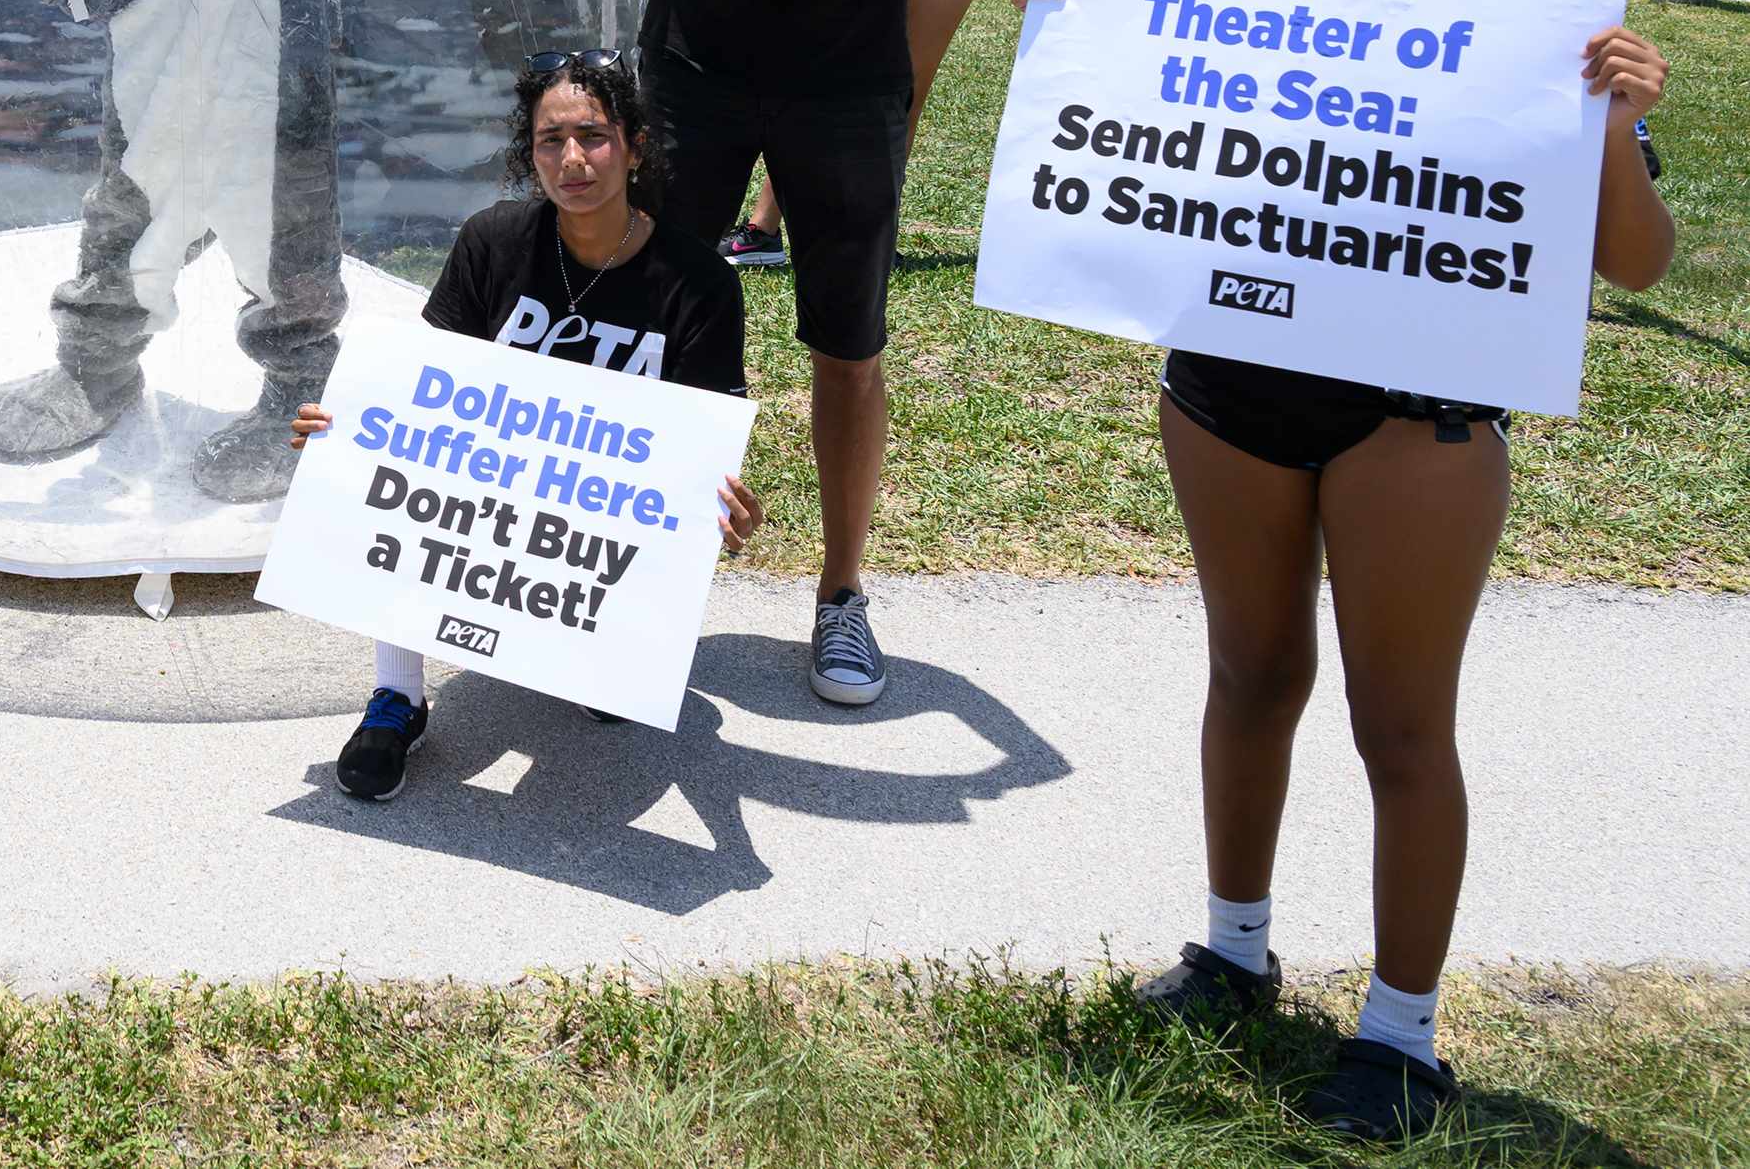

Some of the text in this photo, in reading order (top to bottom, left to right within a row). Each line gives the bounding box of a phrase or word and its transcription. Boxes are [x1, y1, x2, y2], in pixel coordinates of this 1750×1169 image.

[1161, 57, 1417, 137] the Sea:
[1397, 21, 1474, 72] of
[1052, 105, 1525, 223] Send Dolphins
[1033, 164, 1533, 294] to Sanctuaries!
[413, 366, 653, 462] Dolphins
[354, 408, 678, 531] Suffer Here.
[365, 465, 639, 585] Don't Buy
[367, 534, 606, 632] a Ticket!
